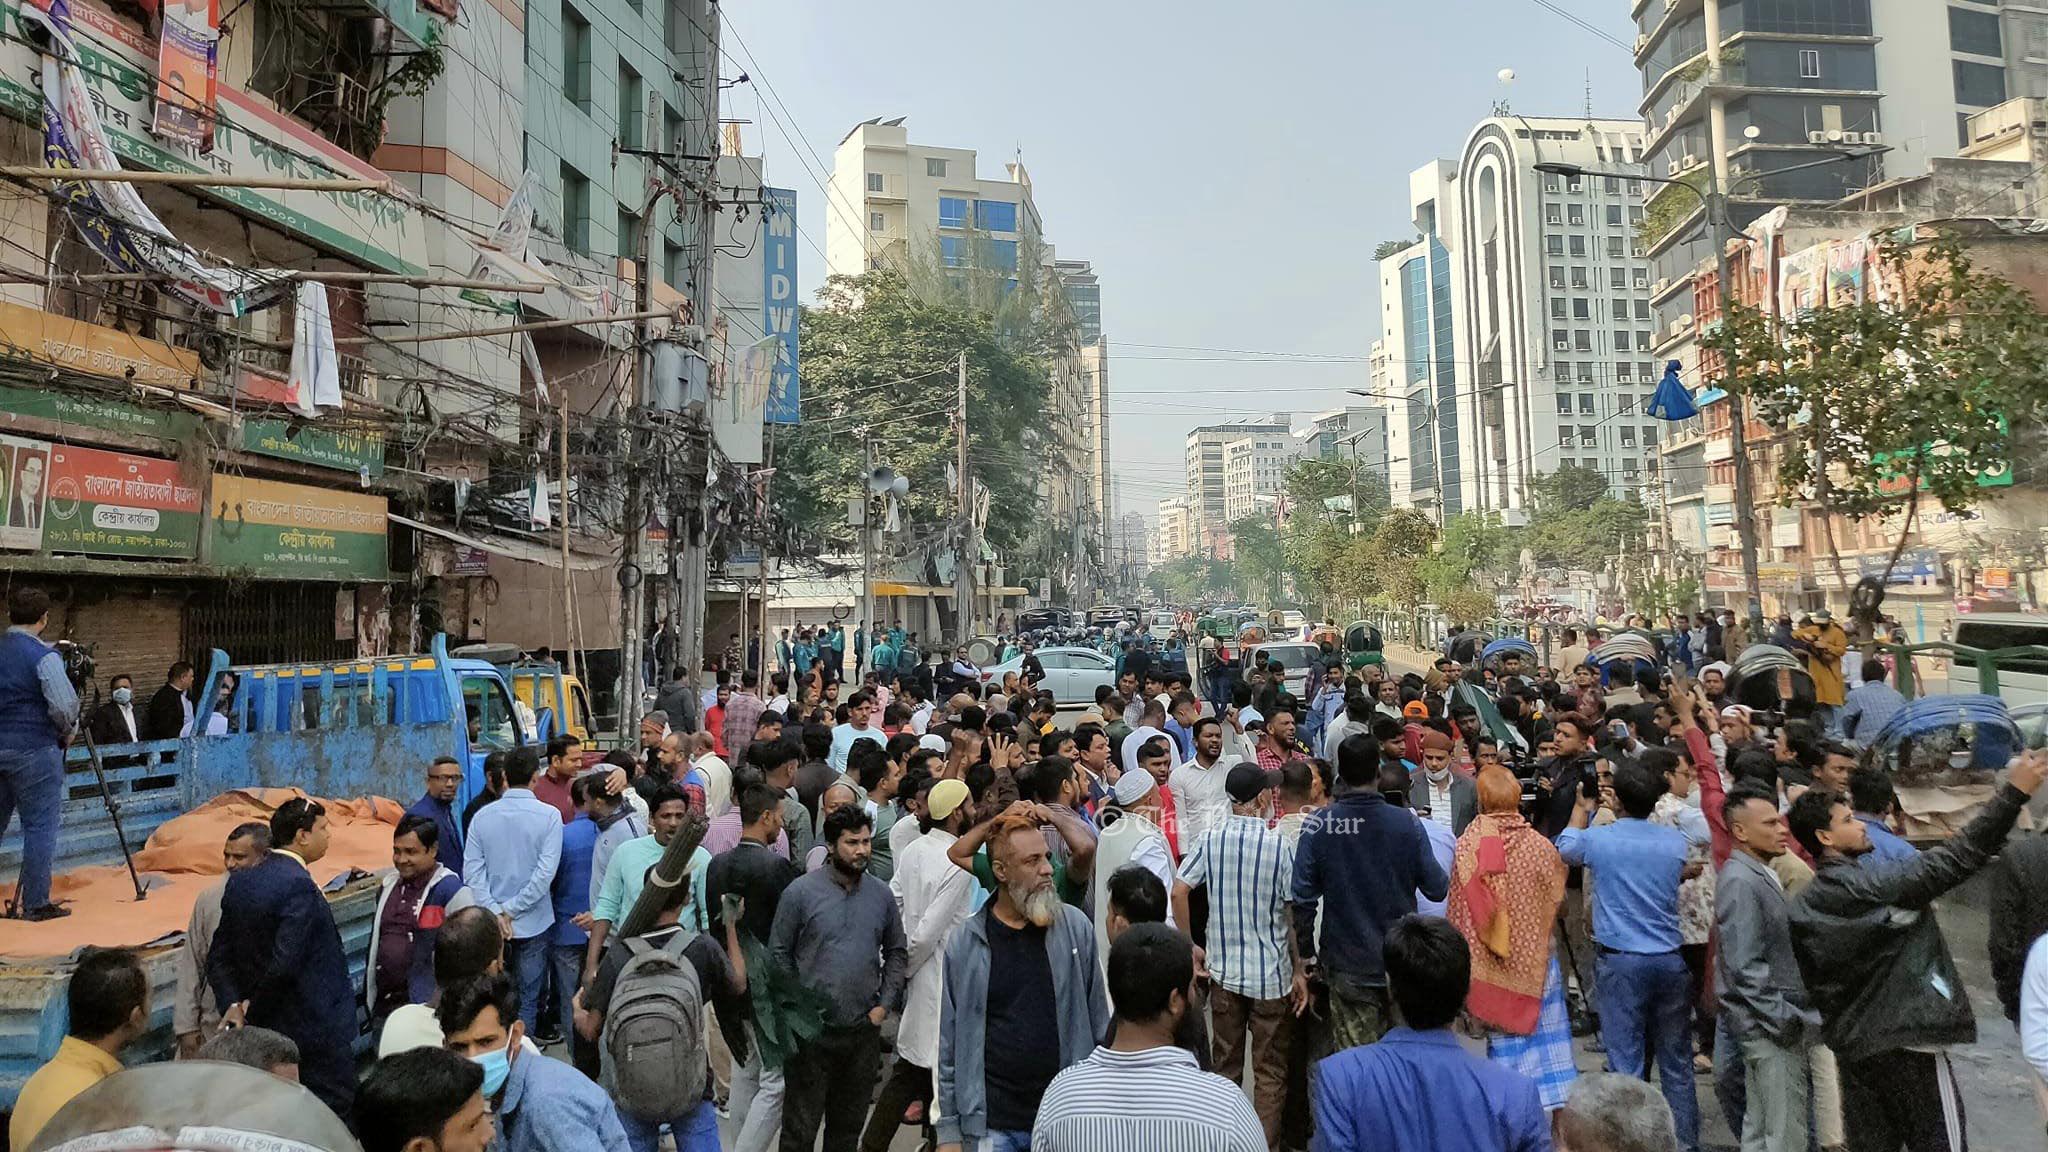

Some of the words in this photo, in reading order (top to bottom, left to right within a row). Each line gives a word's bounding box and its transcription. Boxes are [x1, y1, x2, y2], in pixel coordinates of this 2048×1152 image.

[768, 213, 794, 399] MIDWAY
[85, 474, 123, 496] বাংলাদেশ
[125, 475, 172, 503] জাতীয়তাবাদী
[98, 508, 125, 525] কেন্দ্রীয়
[127, 512, 156, 527] কার্যালয়
[247, 499, 290, 520] বাংলাদেশ
[293, 500, 347, 525] জাতীয়তাবাদী
[279, 528, 305, 549] কেন্দ্রীয়
[307, 531, 336, 550] কার্যালয়
